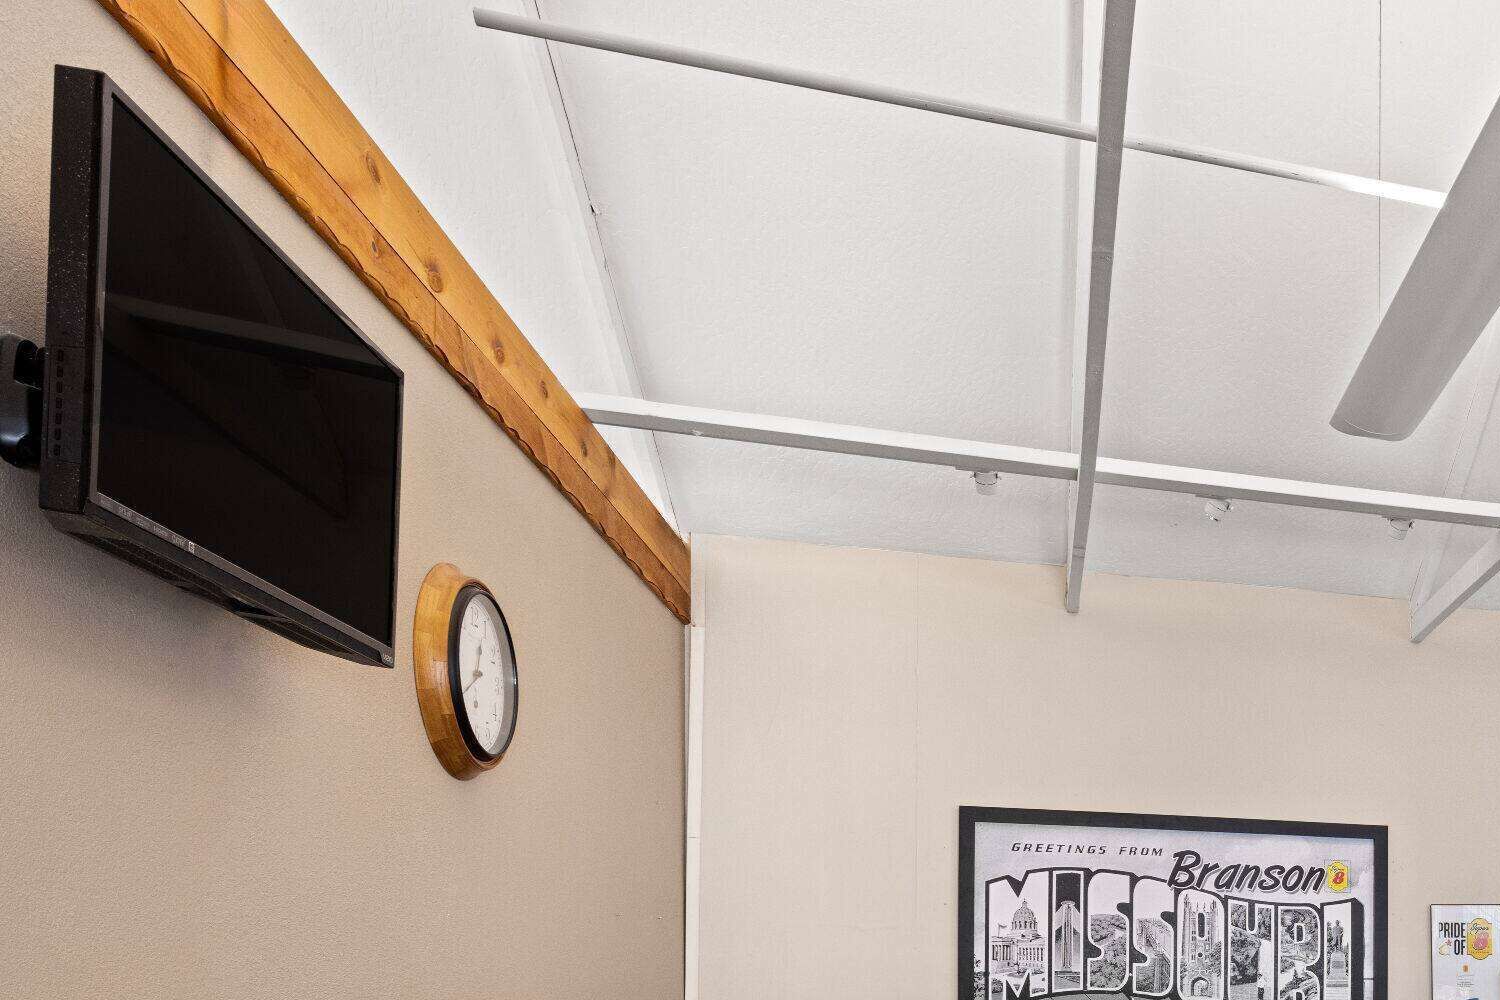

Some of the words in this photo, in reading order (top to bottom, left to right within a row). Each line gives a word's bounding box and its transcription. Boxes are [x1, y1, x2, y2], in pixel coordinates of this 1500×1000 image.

[1010, 842, 1107, 855] GREETINGS
[1118, 846, 1164, 857] FROM
[1166, 850, 1327, 893] Branson
[1438, 922, 1466, 938] PRIDE
[1454, 939, 1466, 955] OF
